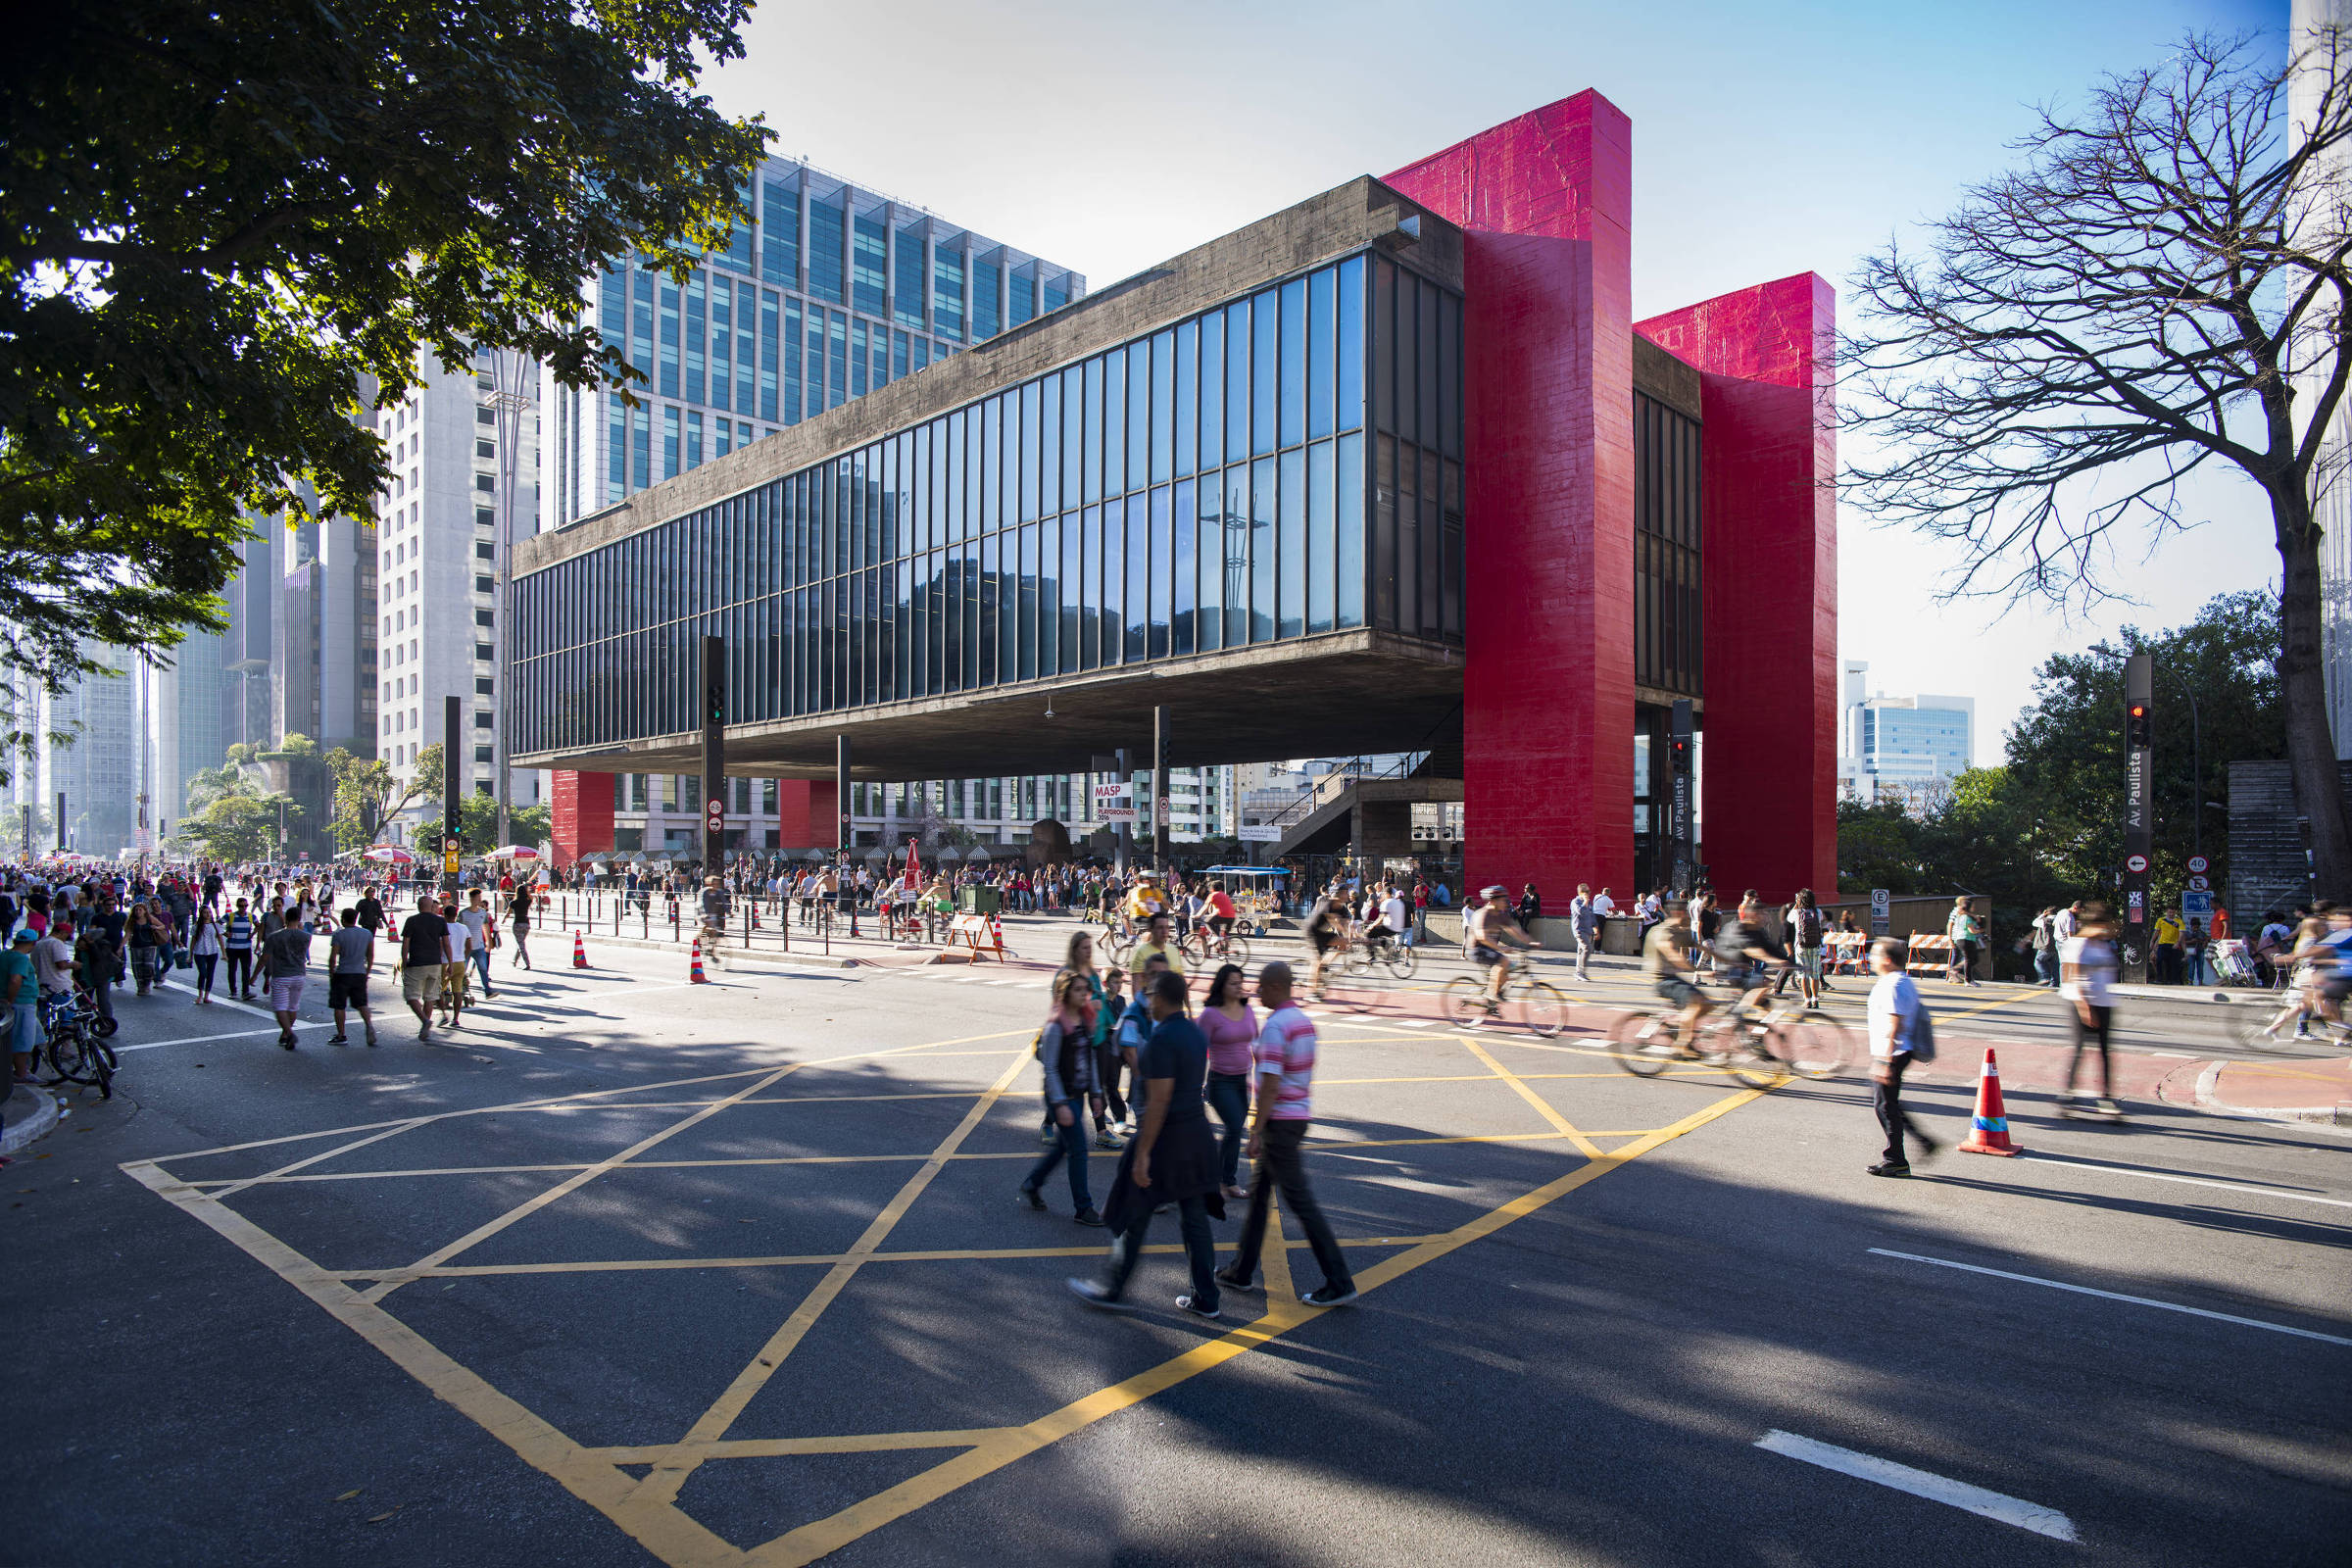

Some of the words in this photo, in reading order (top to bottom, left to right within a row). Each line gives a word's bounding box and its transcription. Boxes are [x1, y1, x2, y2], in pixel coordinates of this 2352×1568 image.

[2129, 752, 2140, 806] Paulista
[1095, 785, 1121, 797] MASP
[1676, 777, 1685, 822] Paulista
[2129, 808, 2140, 827] Av.
[1877, 893, 1885, 902] E
